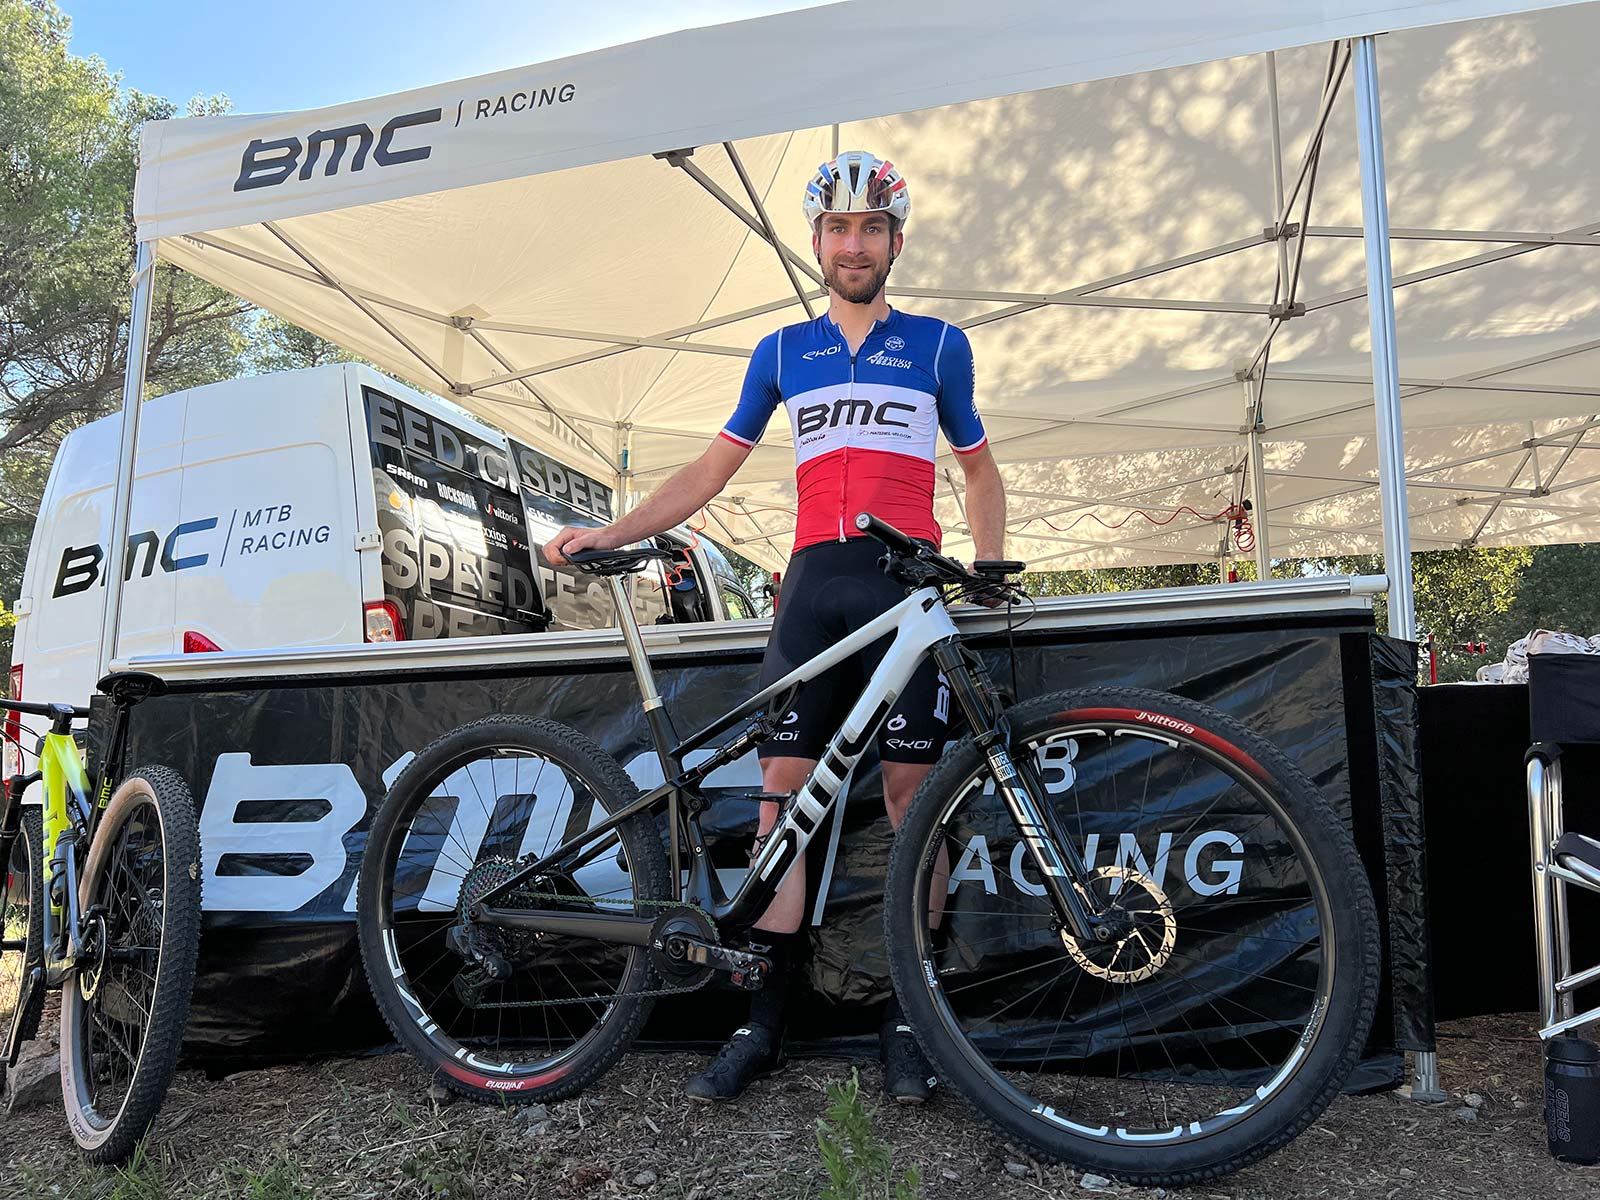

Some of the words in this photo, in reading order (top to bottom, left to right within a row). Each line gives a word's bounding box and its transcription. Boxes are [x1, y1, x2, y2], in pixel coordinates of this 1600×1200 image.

[233, 107, 442, 192] BMC
[474, 83, 577, 120] RACING
[797, 399, 917, 438] BMC
[386, 463, 428, 489] SRAM
[242, 504, 292, 529] MTB
[240, 525, 331, 555] RACING
[382, 528, 534, 611] SPEED
[1146, 713, 1196, 734] vittoria
[98, 777, 113, 809] BMC
[1555, 1088, 1571, 1143] SPEED
